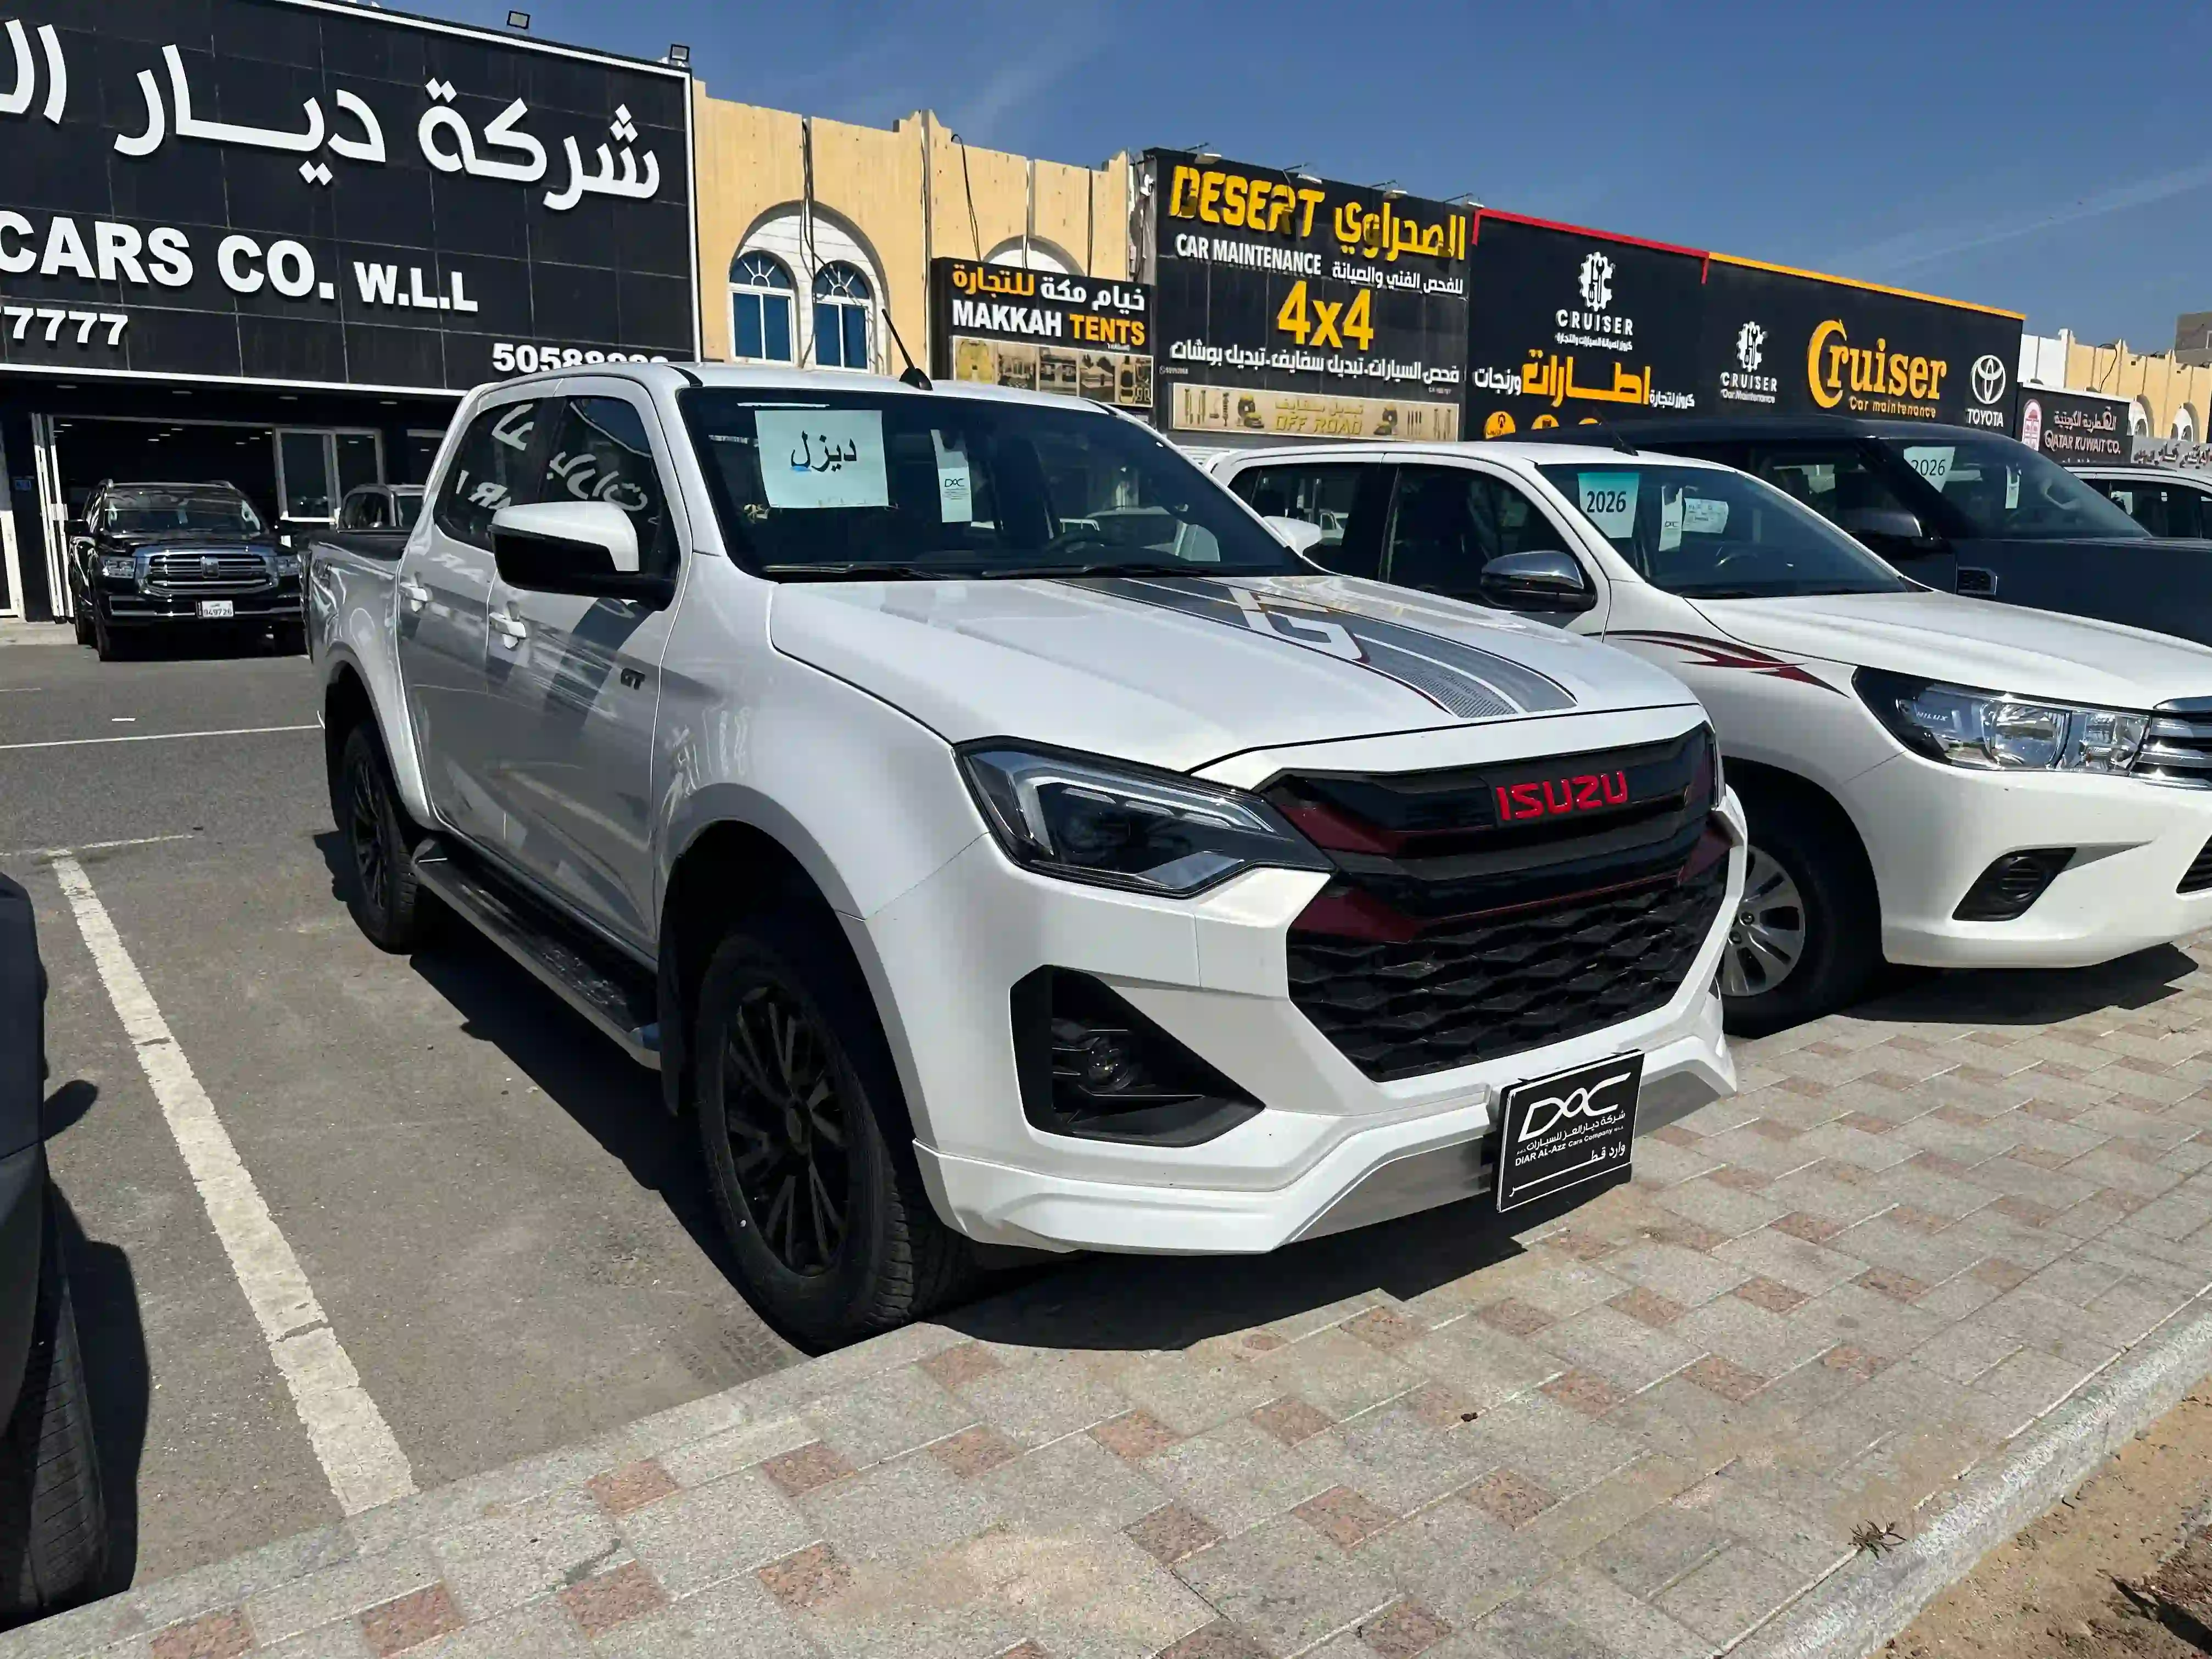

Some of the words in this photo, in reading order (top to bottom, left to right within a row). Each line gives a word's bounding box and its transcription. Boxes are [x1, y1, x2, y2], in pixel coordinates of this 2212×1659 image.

[114, 43, 386, 186] ديار
[418, 77, 661, 212] شركة
[1169, 165, 1325, 237] DESERT
[1335, 202, 1466, 262] الصحراوي
[0, 210, 193, 286] CARS
[217, 234, 334, 299] CO.
[353, 261, 478, 312] W.L.L
[1175, 233, 1209, 260] CAR
[1213, 239, 1322, 275] MAINTENANCE
[952, 264, 1035, 299] للتجارة
[1332, 261, 1384, 289] والصيانة
[1386, 271, 1421, 290] الفني
[1423, 277, 1464, 294] للفحص
[1040, 276, 1087, 303] مكة
[1092, 285, 1146, 315] خيام
[952, 298, 1062, 337] MAKKAH
[1069, 313, 1146, 346] TENTS
[1276, 280, 1373, 351] 4x4
[1555, 309, 1633, 336] CRUISER
[1170, 338, 1223, 367] بوشات
[1225, 344, 1265, 371] تبديل
[1808, 319, 1947, 409] Cruiser
[1327, 354, 1364, 379] تبديل
[1422, 366, 1459, 384] فحص
[1720, 372, 1777, 392] CRUISER
[1849, 395, 1869, 410] Car
[1873, 399, 1936, 418] maintenance
[1965, 408, 2004, 428] TOYOTA
[1276, 415, 1308, 432] OFF
[1314, 418, 1362, 435] ROAD
[791, 430, 857, 472] ديزل
[2045, 430, 2074, 452] QATAR
[2075, 435, 2106, 454] KUWAIT
[2106, 439, 2121, 455] CO.
[1911, 459, 1946, 476] 2026
[1586, 490, 1627, 513] 2026
[621, 667, 645, 690] GT
[1495, 770, 1628, 821] ISUZU
[1601, 1109, 1626, 1126] شركة
[1515, 1152, 1537, 1166] DIAR
[1568, 1138, 1583, 1147] Cars
[1584, 1127, 1613, 1142] Company
[1526, 1131, 1562, 1150] للسيارات
[1609, 1141, 1626, 1159] وارد
